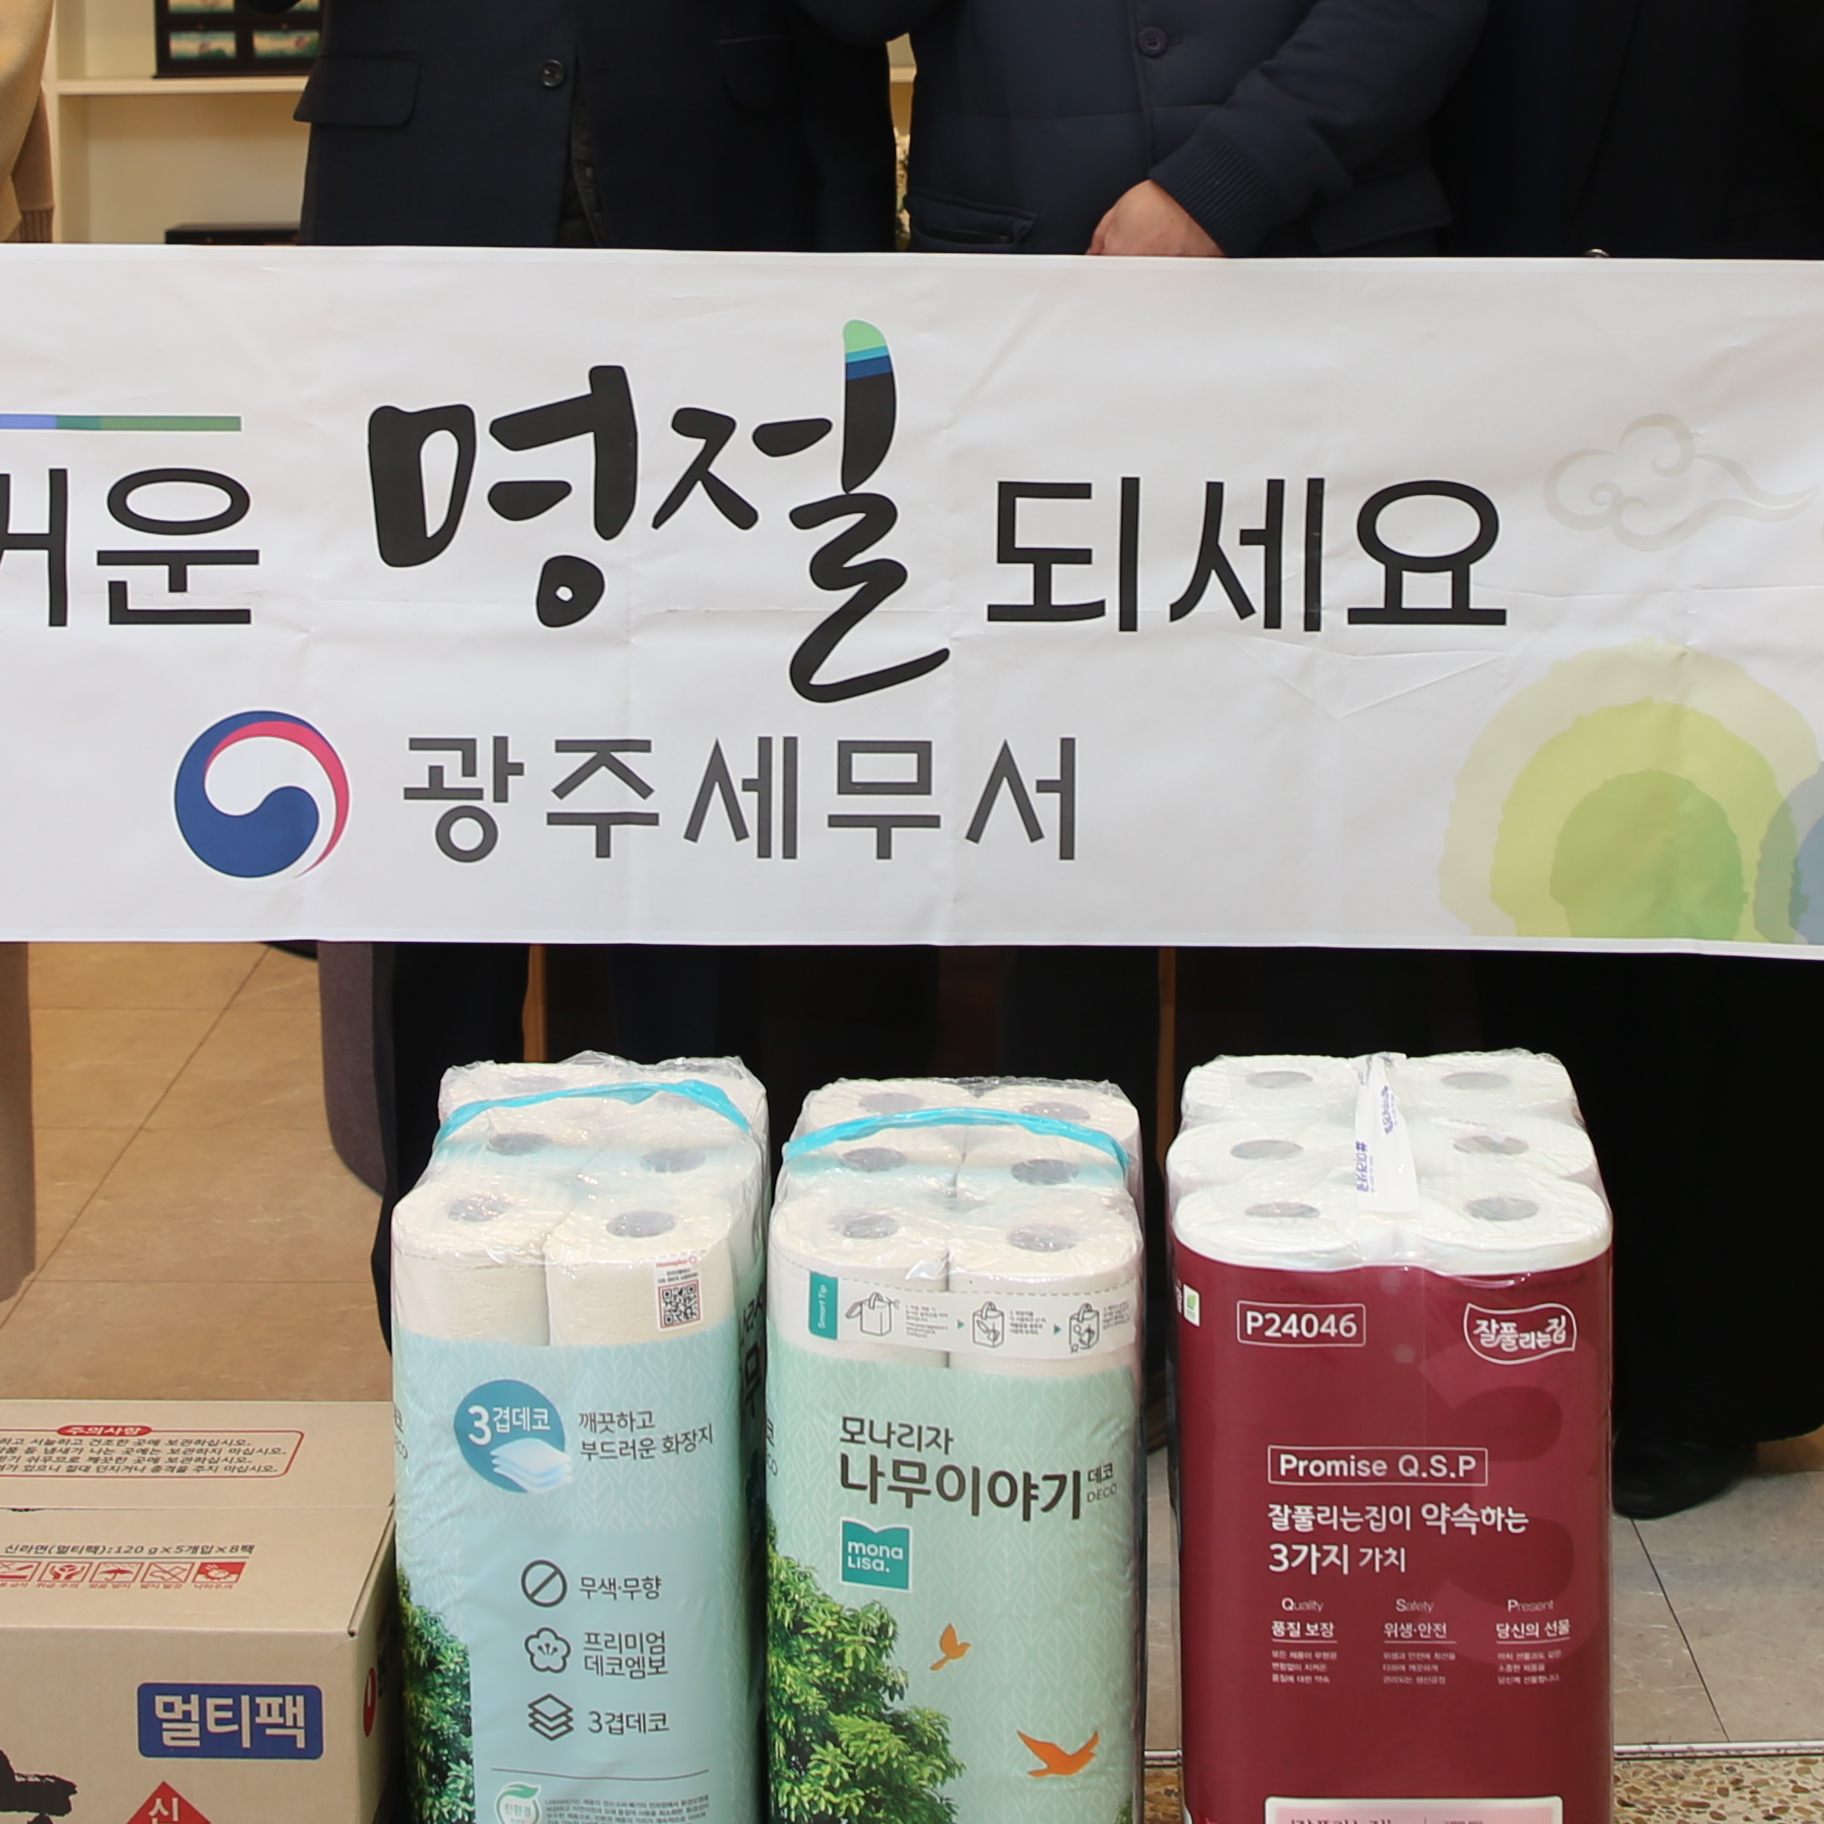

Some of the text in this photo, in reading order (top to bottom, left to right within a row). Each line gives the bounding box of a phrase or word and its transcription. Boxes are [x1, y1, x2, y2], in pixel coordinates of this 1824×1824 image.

[367, 317, 951, 705] 명절
[986, 475, 1507, 633] 되세요
[402, 733, 1079, 863] 광주세무서
[1245, 1310, 1358, 1339] P24046
[1473, 1314, 1568, 1352] 잘풀리는집
[65, 1426, 143, 1436] 주의사항
[466, 1404, 552, 1446] 3겹데코
[577, 1410, 656, 1434] 깨끗하고
[579, 1423, 715, 1462] 부드러운 화장지
[839, 1416, 954, 1455] 모나리자
[1087, 1462, 1114, 1484] 데코
[1279, 1454, 1477, 1479] Promise Q.S.P
[840, 1453, 1081, 1522] 나무이야기
[1086, 1482, 1118, 1503] DECO
[1268, 1502, 1529, 1536] 잘풀리는집이 약속하는
[847, 1540, 904, 1561] mona
[1268, 1542, 1406, 1576] 3가지 가치
[1281, 1597, 1324, 1613] Quality
[1395, 1598, 1435, 1614] Safety
[1507, 1598, 1555, 1613] Present
[1272, 1621, 1335, 1639] 품질 보장
[1495, 1619, 1571, 1639] 당신의 선물
[583, 1630, 666, 1655] 프리미엄
[583, 1654, 669, 1680] 데코엠보
[154, 1693, 307, 1751] 멀티팩
[587, 1710, 670, 1736] 3겹데코
